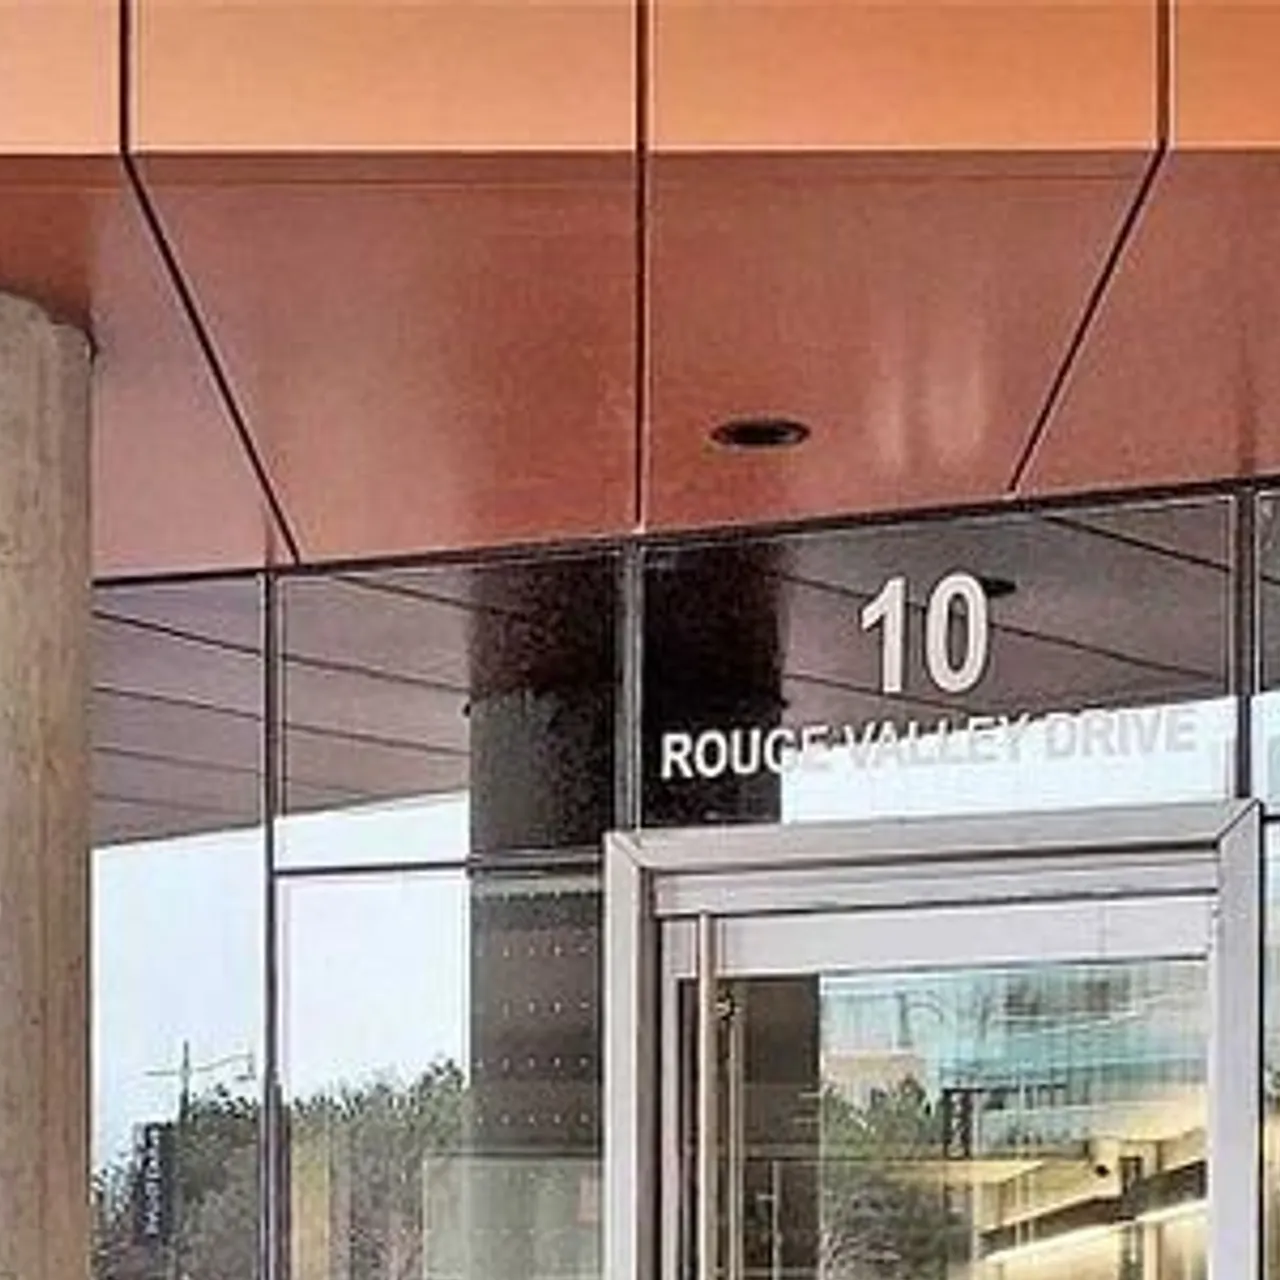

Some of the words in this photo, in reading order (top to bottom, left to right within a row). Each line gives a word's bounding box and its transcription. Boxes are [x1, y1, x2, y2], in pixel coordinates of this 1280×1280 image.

[859, 571, 990, 693] 10
[660, 725, 828, 780] ROUGE
[844, 714, 1032, 769] VALLEY
[1046, 708, 1198, 757] DRIVE
